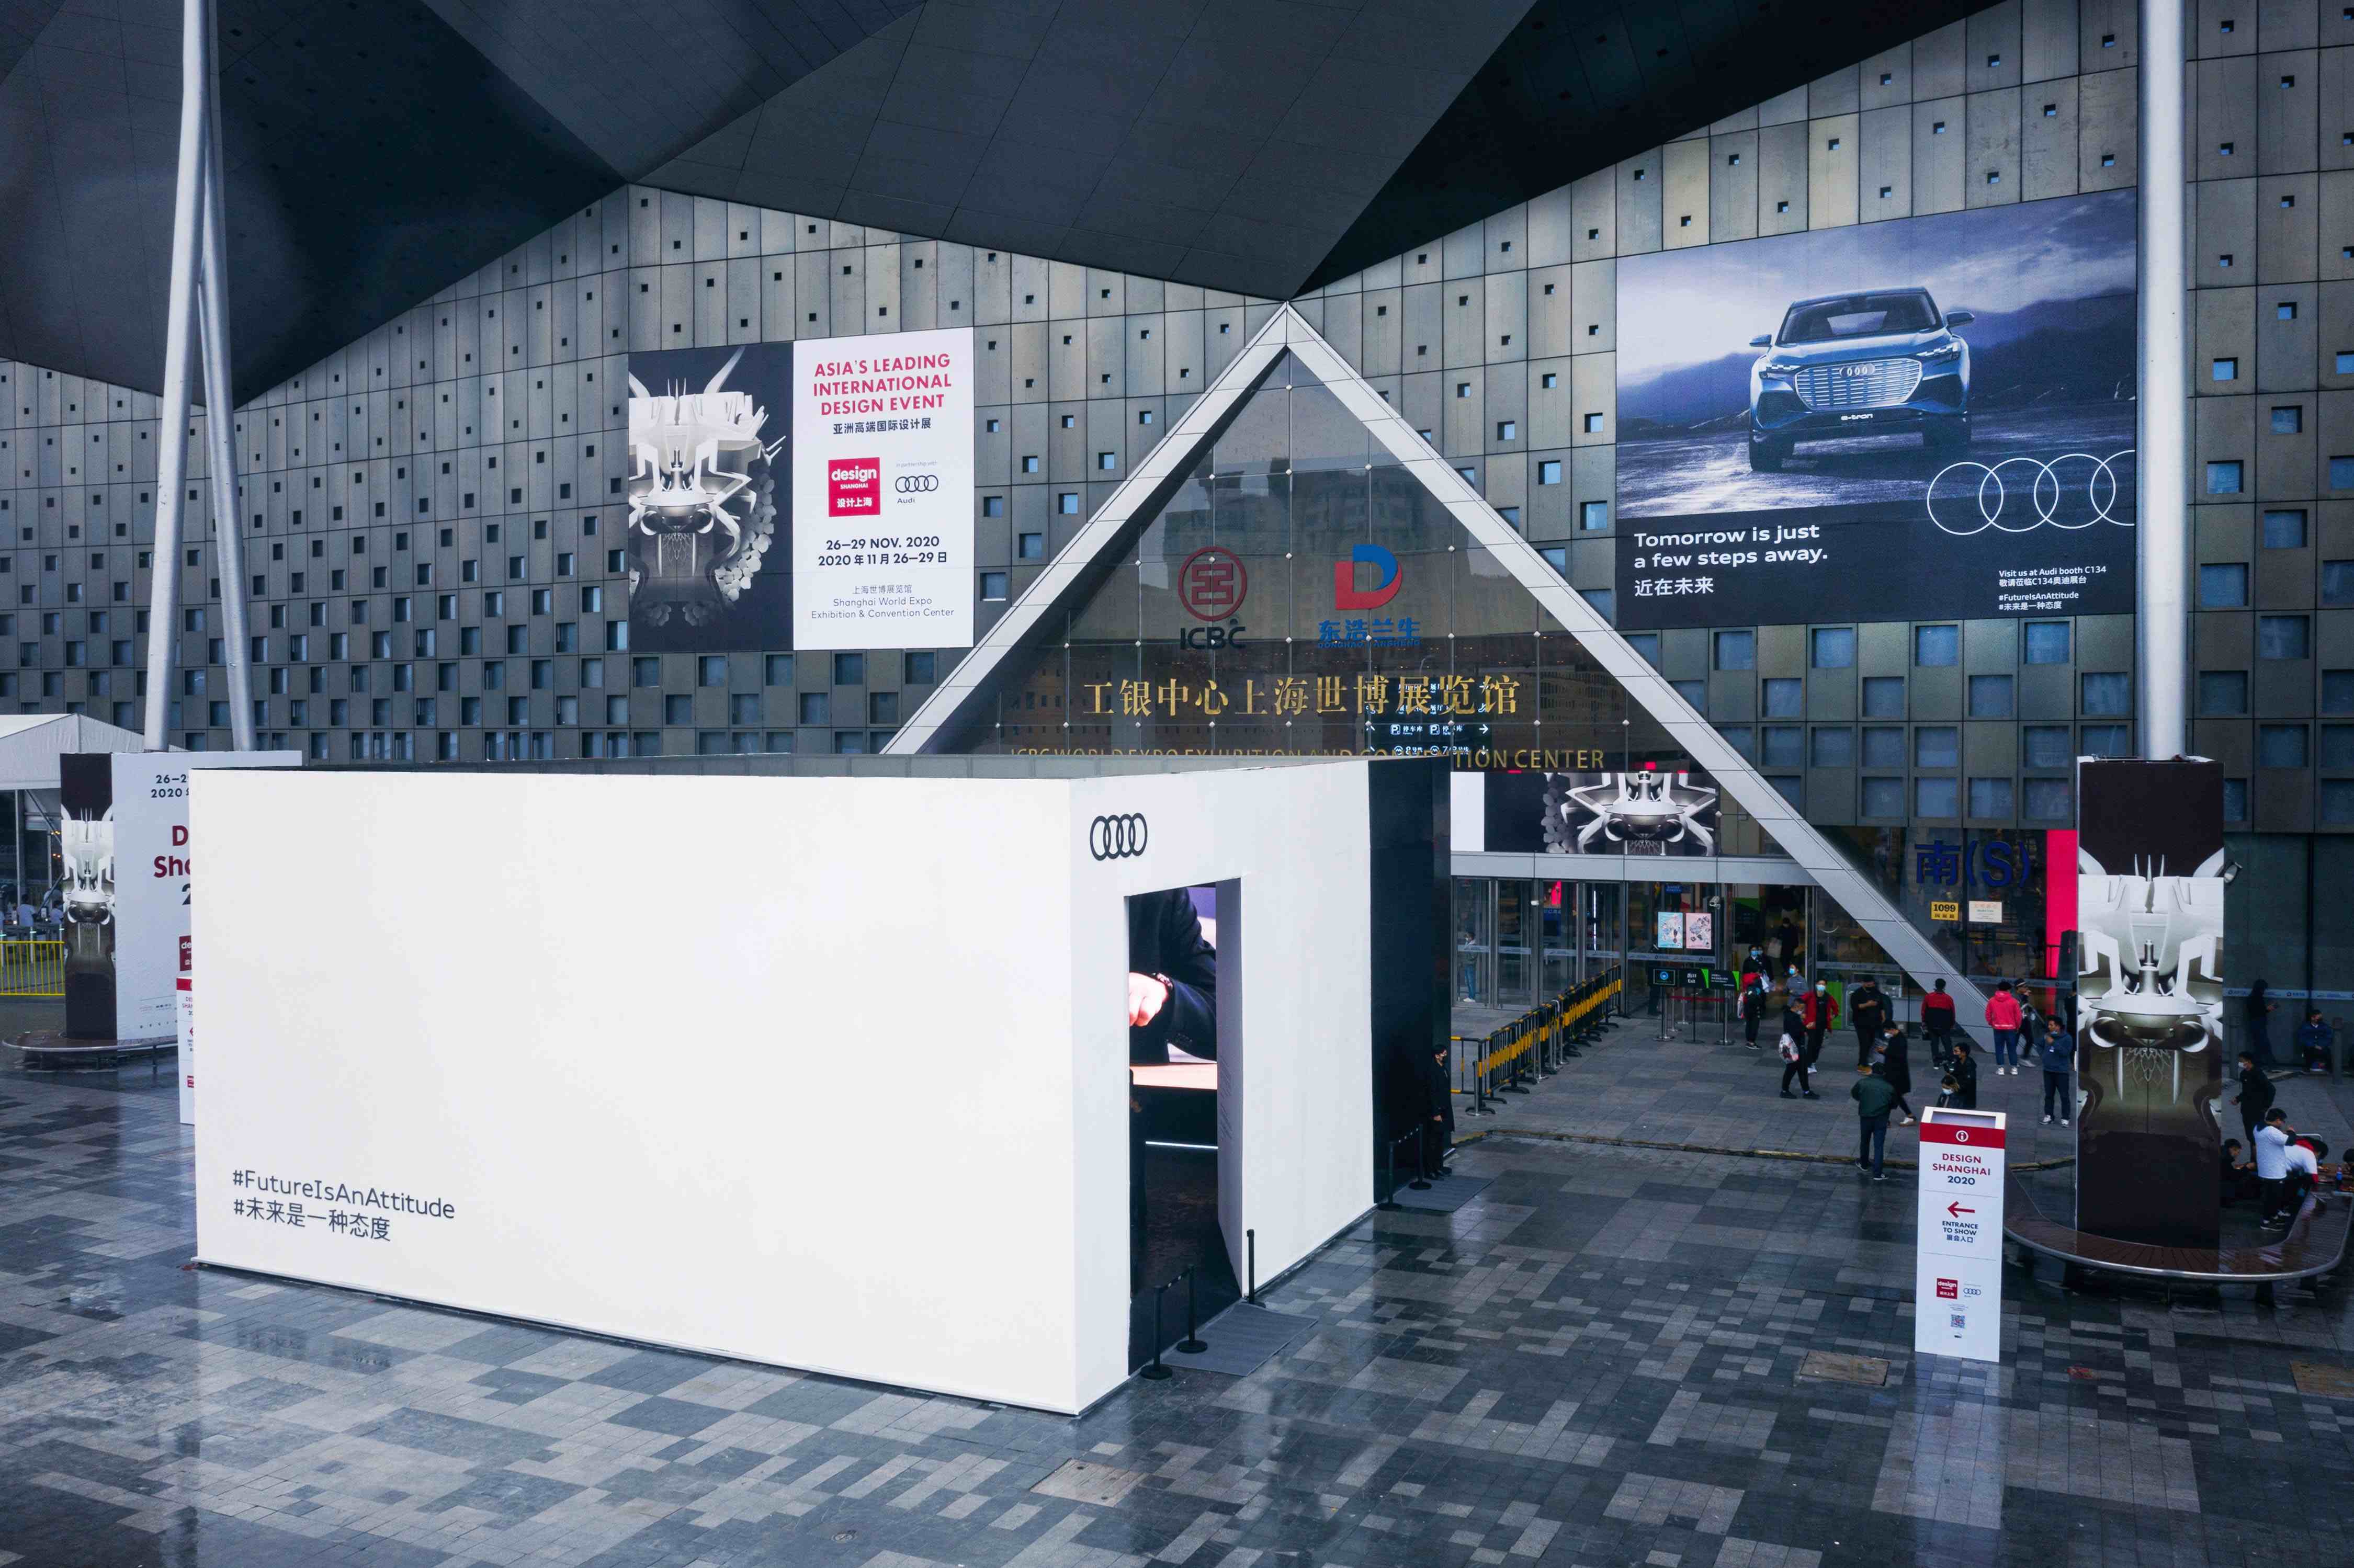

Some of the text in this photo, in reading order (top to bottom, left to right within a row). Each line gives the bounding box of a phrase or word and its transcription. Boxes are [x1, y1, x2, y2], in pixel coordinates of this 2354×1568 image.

[814, 353, 950, 377] ASIA'S LEADING
[813, 373, 952, 396] INTERNATIONAL
[821, 394, 945, 416] DESIGN EVENT
[833, 417, 932, 435] 亚洲高端国际设计展
[831, 465, 877, 482] design
[837, 497, 873, 508] 设计上海
[870, 537, 902, 549] NOV.
[906, 536, 940, 548] 2020
[1634, 524, 1820, 548] Tomorrow is just
[1634, 548, 1828, 569] a few steps away.
[1634, 576, 1714, 597] 近在未来
[1999, 576, 2087, 587] 敬请莅临C134奥迪展台
[853, 584, 912, 595] 上海世博展览馆
[833, 597, 932, 608] Shanghai World Expo
[1999, 592, 2079, 601] #FutureIsAnAttitude
[1999, 601, 2062, 611] #未来是一种态度
[811, 610, 856, 619] Exhibition
[868, 608, 921, 618] Convention
[923, 608, 955, 617] Center
[1318, 618, 1421, 641] 东浩兰生
[1180, 626, 1246, 650] ICBC
[1083, 675, 1521, 717] 工银中心上海世博展览馆
[1514, 749, 1605, 769] CENTER
[151, 788, 183, 798] 2020
[1933, 904, 1956, 912] 1099
[1942, 1153, 1982, 1164] DESIGN
[1932, 1163, 1990, 1176] SHANGHAI
[1948, 1175, 1975, 1186] 2020
[233, 1169, 455, 1219] #FutureIsAnAttitude
[234, 1197, 391, 1242] #未来是一种态度
[1942, 1220, 1978, 1230] ENTRANCE
[1946, 1234, 1973, 1243] 展会入口
